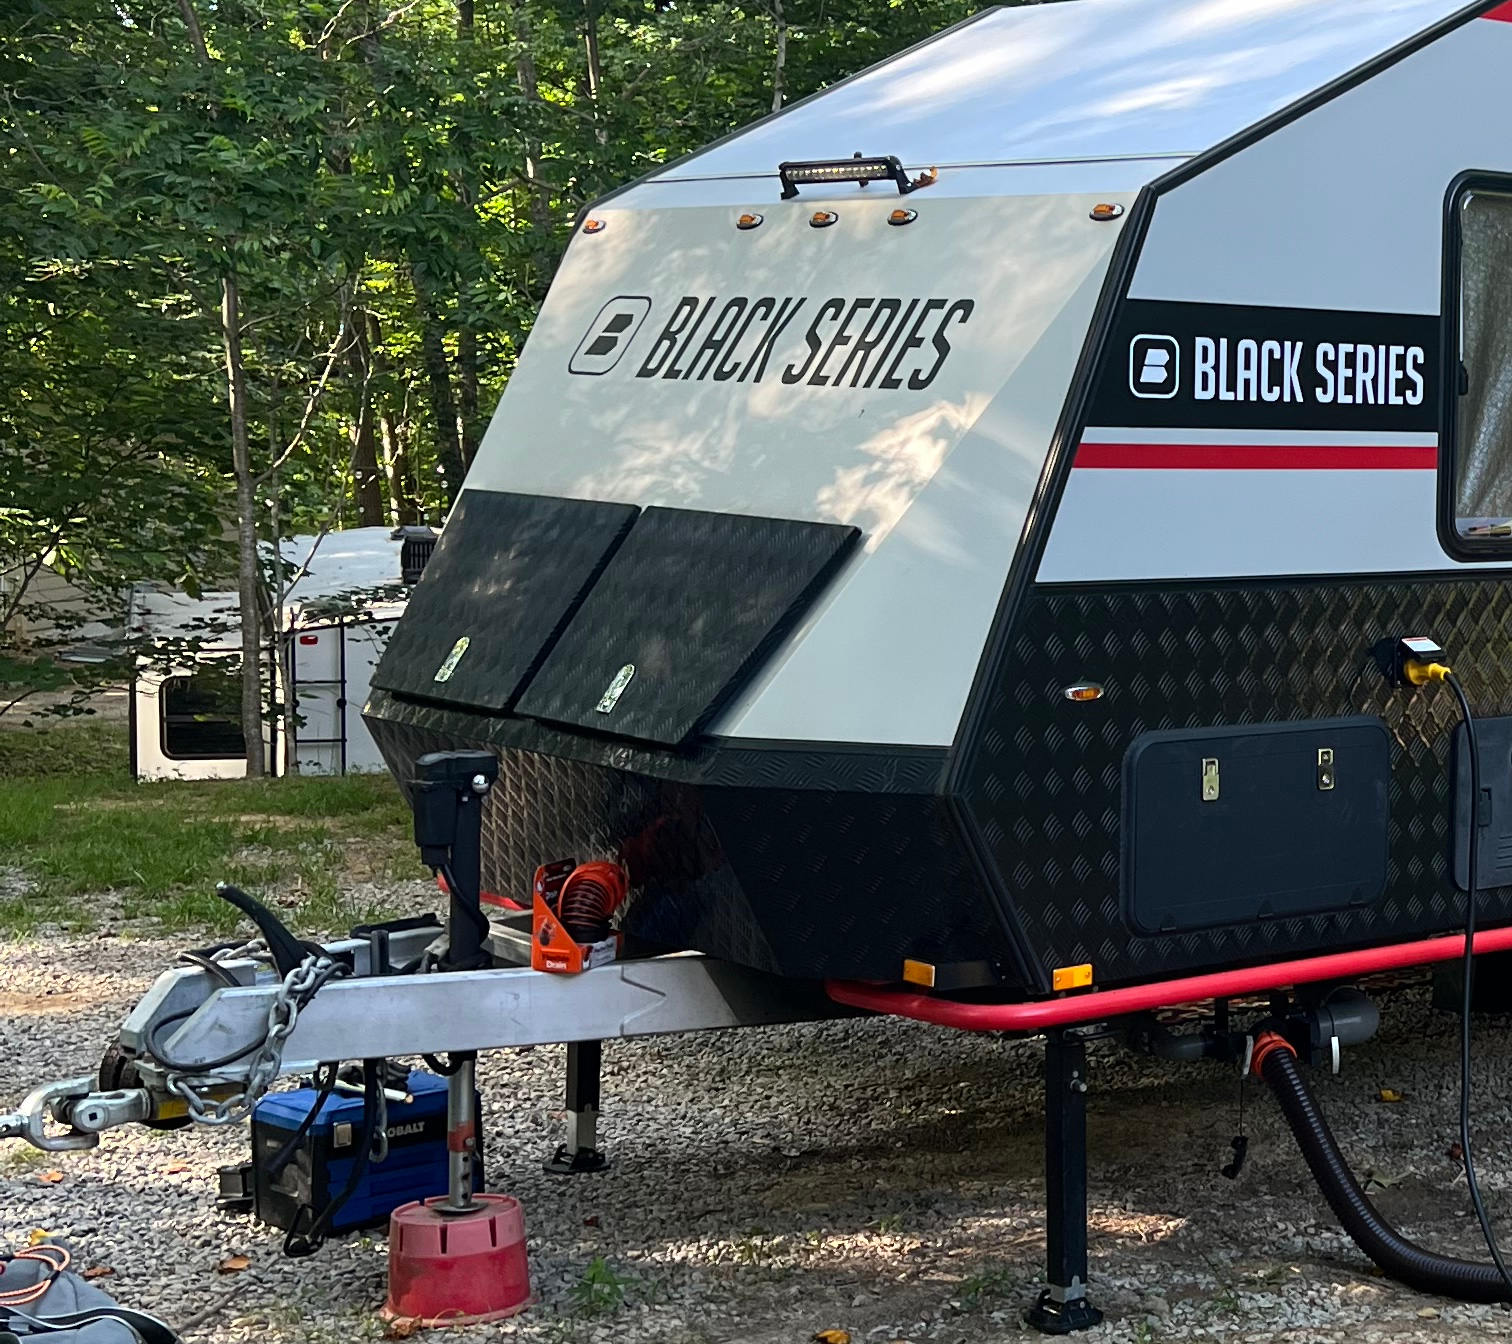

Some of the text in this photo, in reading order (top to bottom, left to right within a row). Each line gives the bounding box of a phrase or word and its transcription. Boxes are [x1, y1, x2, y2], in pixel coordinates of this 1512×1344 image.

[635, 296, 808, 384] BLACK
[780, 297, 976, 391] SERIES
[1194, 336, 1304, 403] BLACK
[1315, 342, 1425, 406] SERIES
[374, 1121, 425, 1138] OBALT
